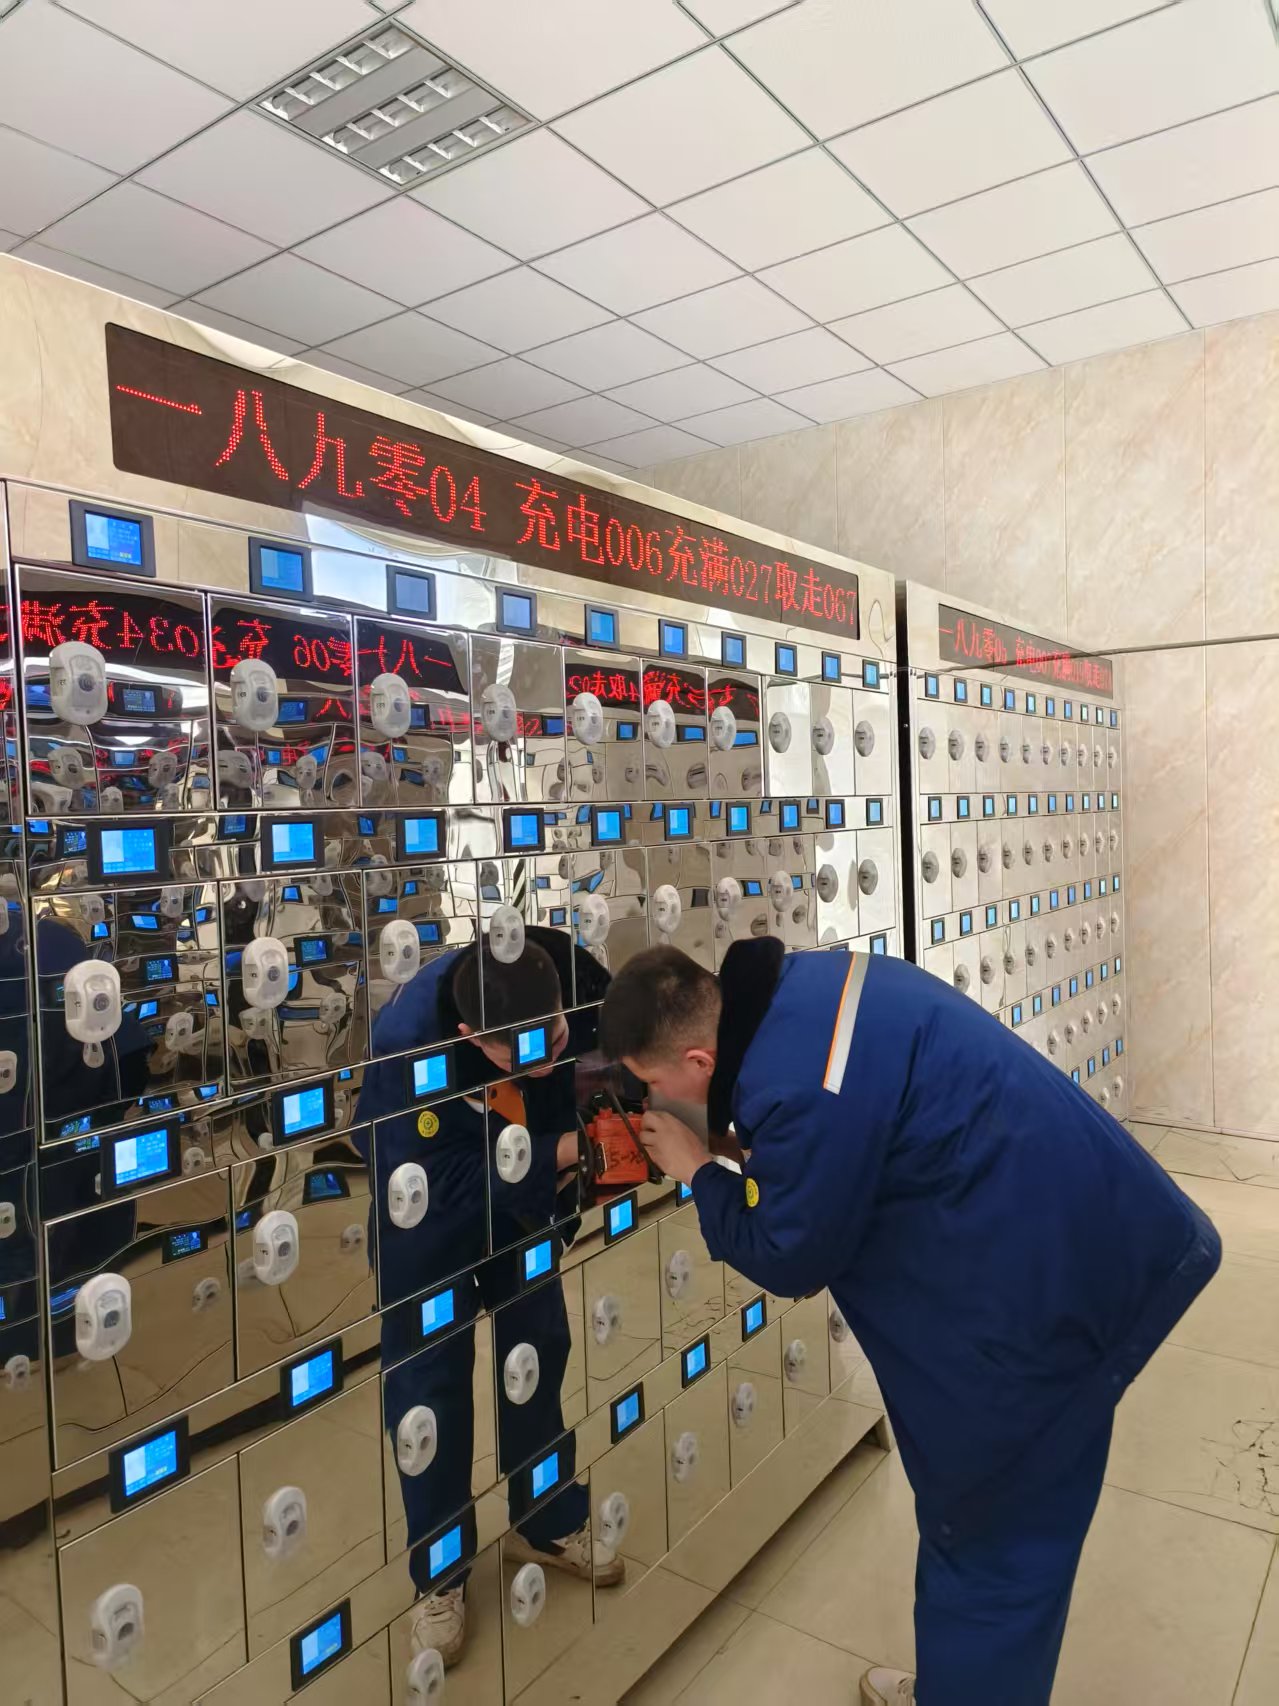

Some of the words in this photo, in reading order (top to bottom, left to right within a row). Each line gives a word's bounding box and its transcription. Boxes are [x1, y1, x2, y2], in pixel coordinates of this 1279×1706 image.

[116, 385, 487, 532] 一八九零04
[515, 478, 857, 625] 充电006充满027取走067
